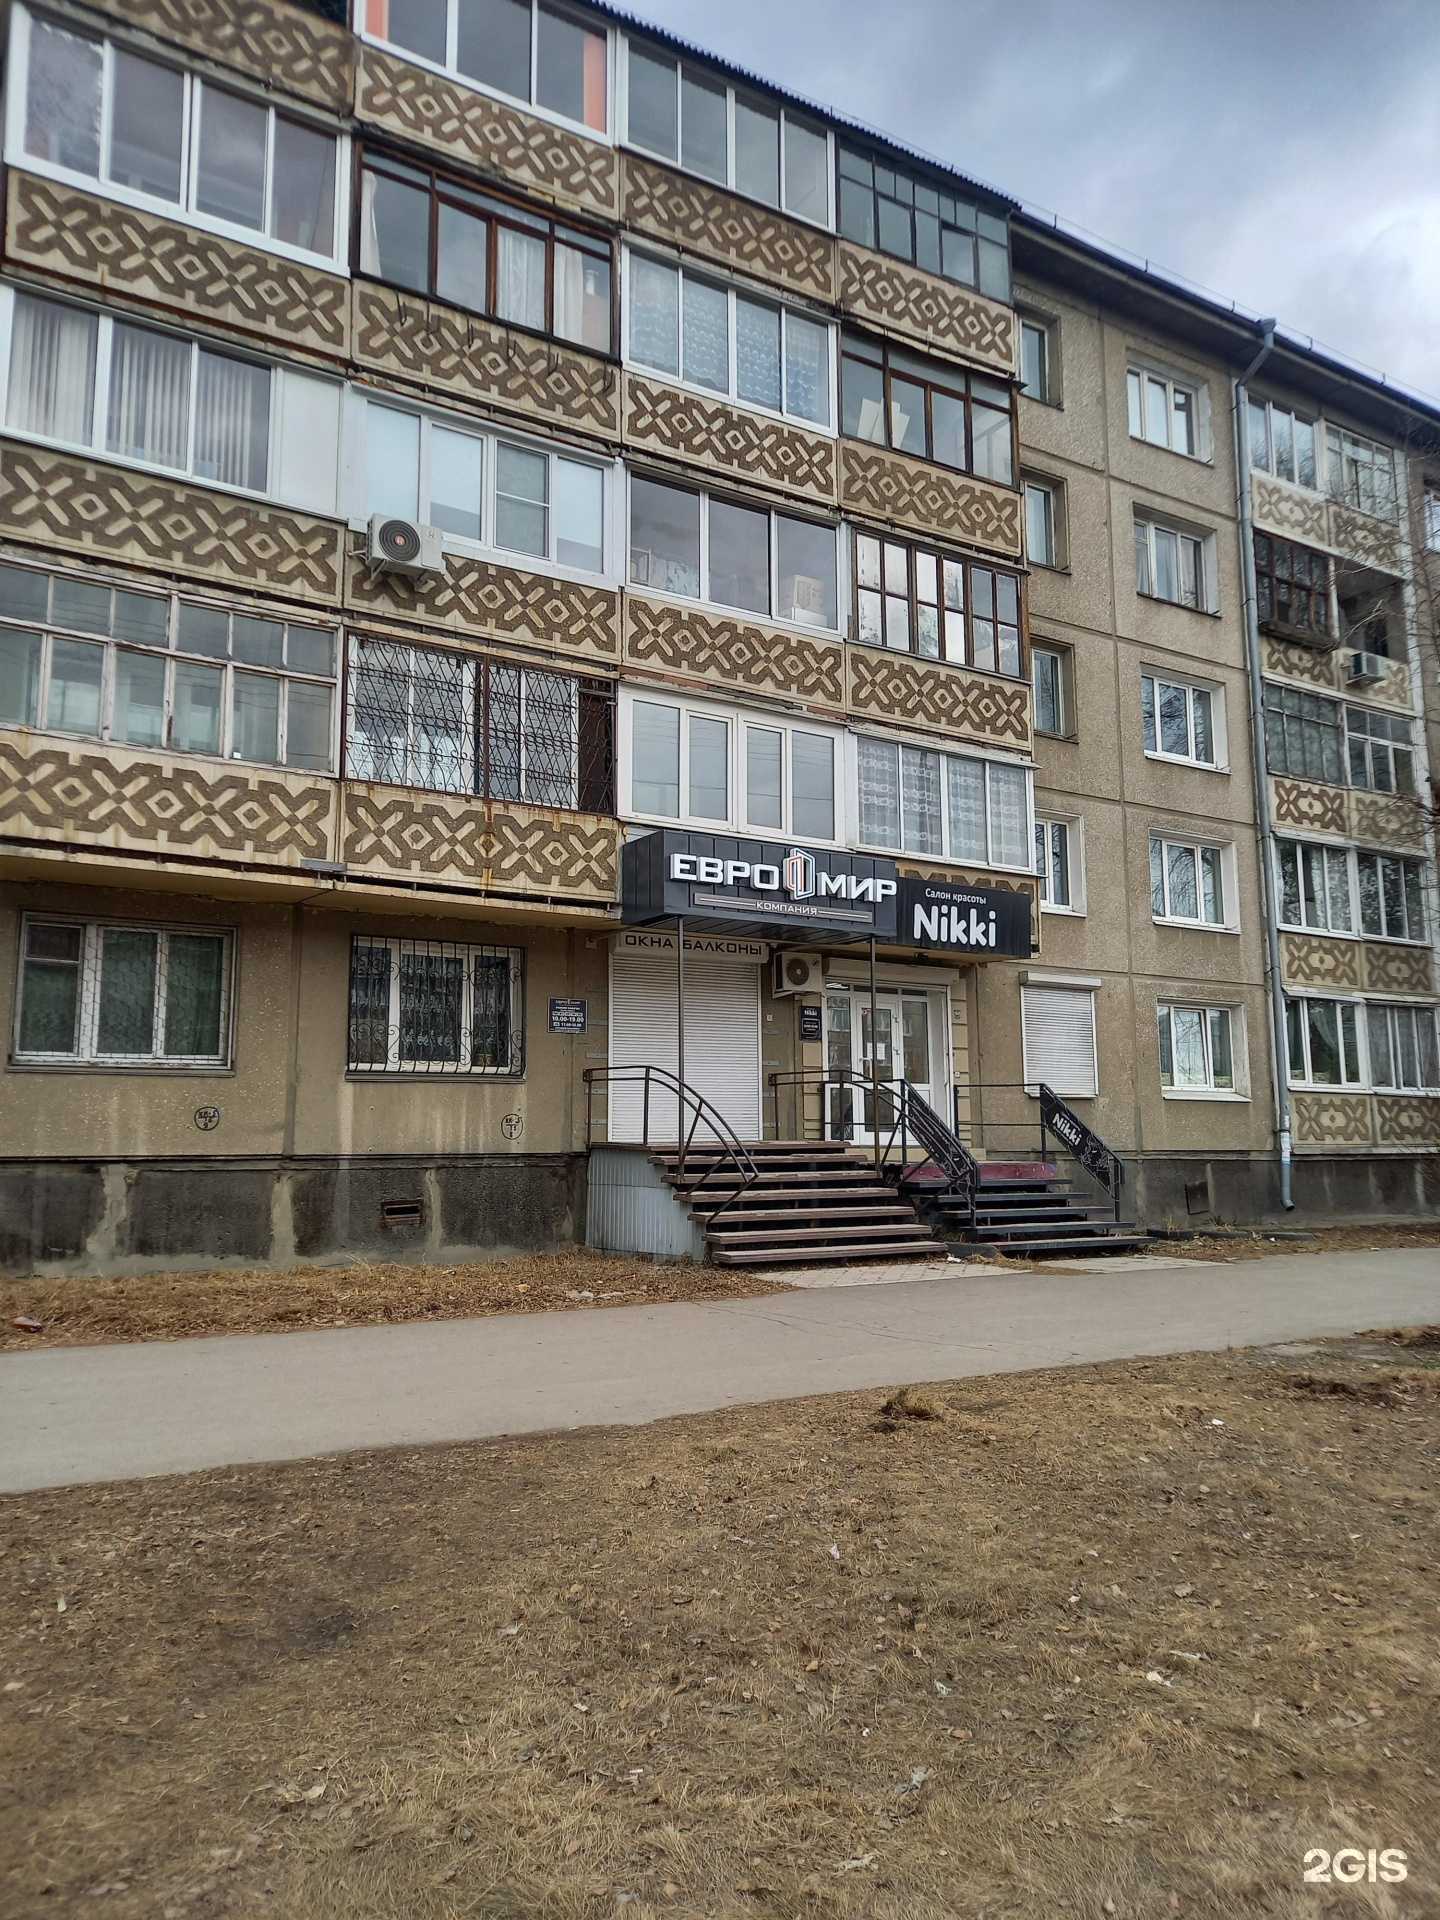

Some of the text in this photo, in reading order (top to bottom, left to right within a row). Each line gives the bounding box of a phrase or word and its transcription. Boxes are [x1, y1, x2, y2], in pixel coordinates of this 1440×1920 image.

[670, 853, 898, 903] ЕВРО МИР
[756, 901, 818, 916] КОМПАНИЯ
[925, 888, 987, 904] Салон красоты
[913, 903, 996, 947] Nikki
[625, 934, 762, 955] ОКНА БАЛКОНЫ
[1052, 1113, 1082, 1145] Nikki
